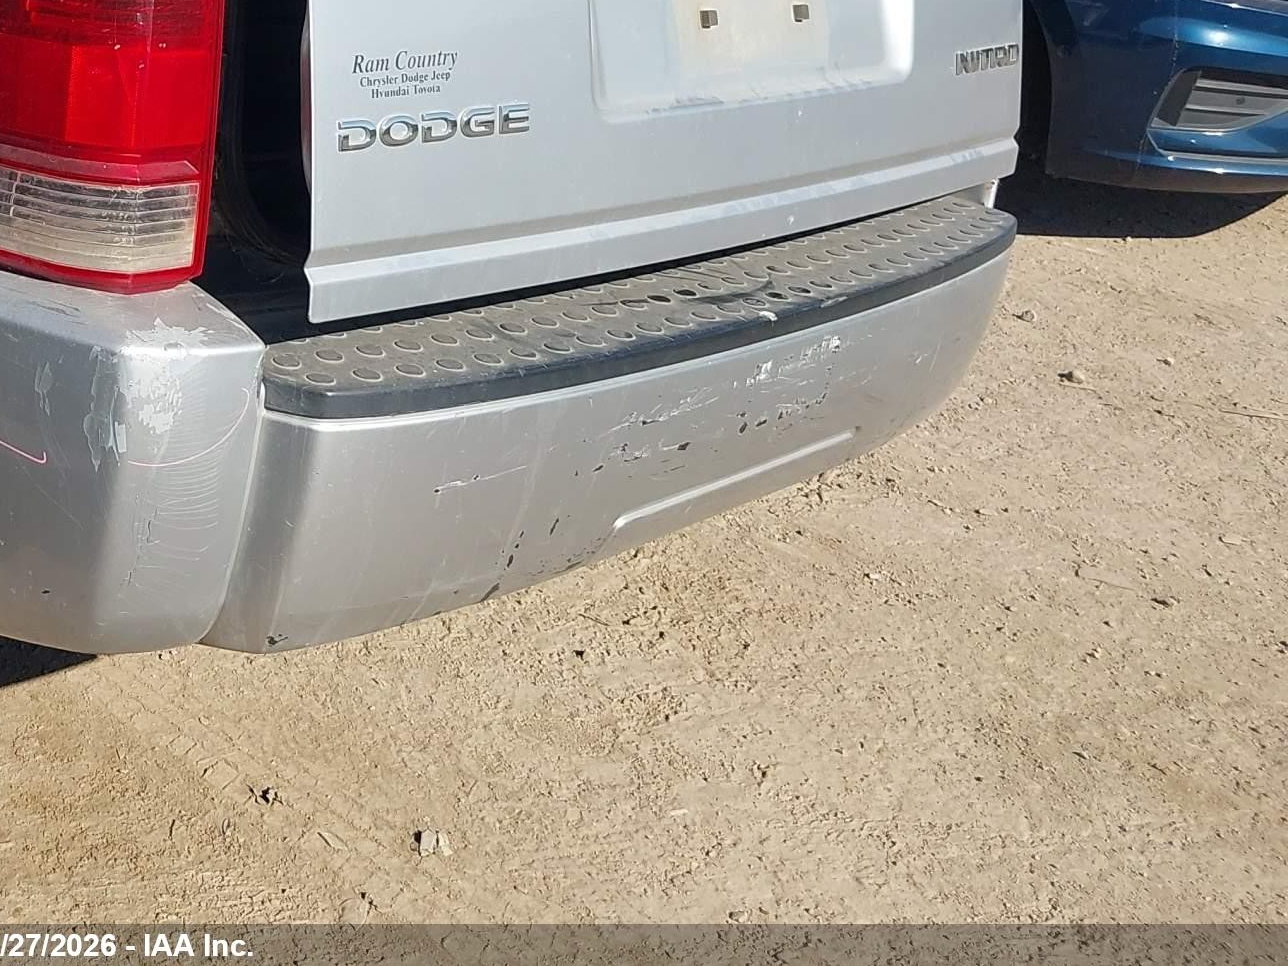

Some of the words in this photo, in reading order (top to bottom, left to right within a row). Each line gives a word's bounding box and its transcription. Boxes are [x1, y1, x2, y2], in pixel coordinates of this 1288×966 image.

[351, 53, 389, 74] Ram
[395, 50, 458, 71] Country
[955, 43, 1019, 76] NITRO
[359, 75, 399, 87] Chrysler
[401, 72, 429, 83] Dodge
[430, 70, 451, 81] Jeep
[371, 85, 410, 99] Hyundai
[413, 84, 441, 95] Toyota
[337, 102, 530, 152] DODGE
